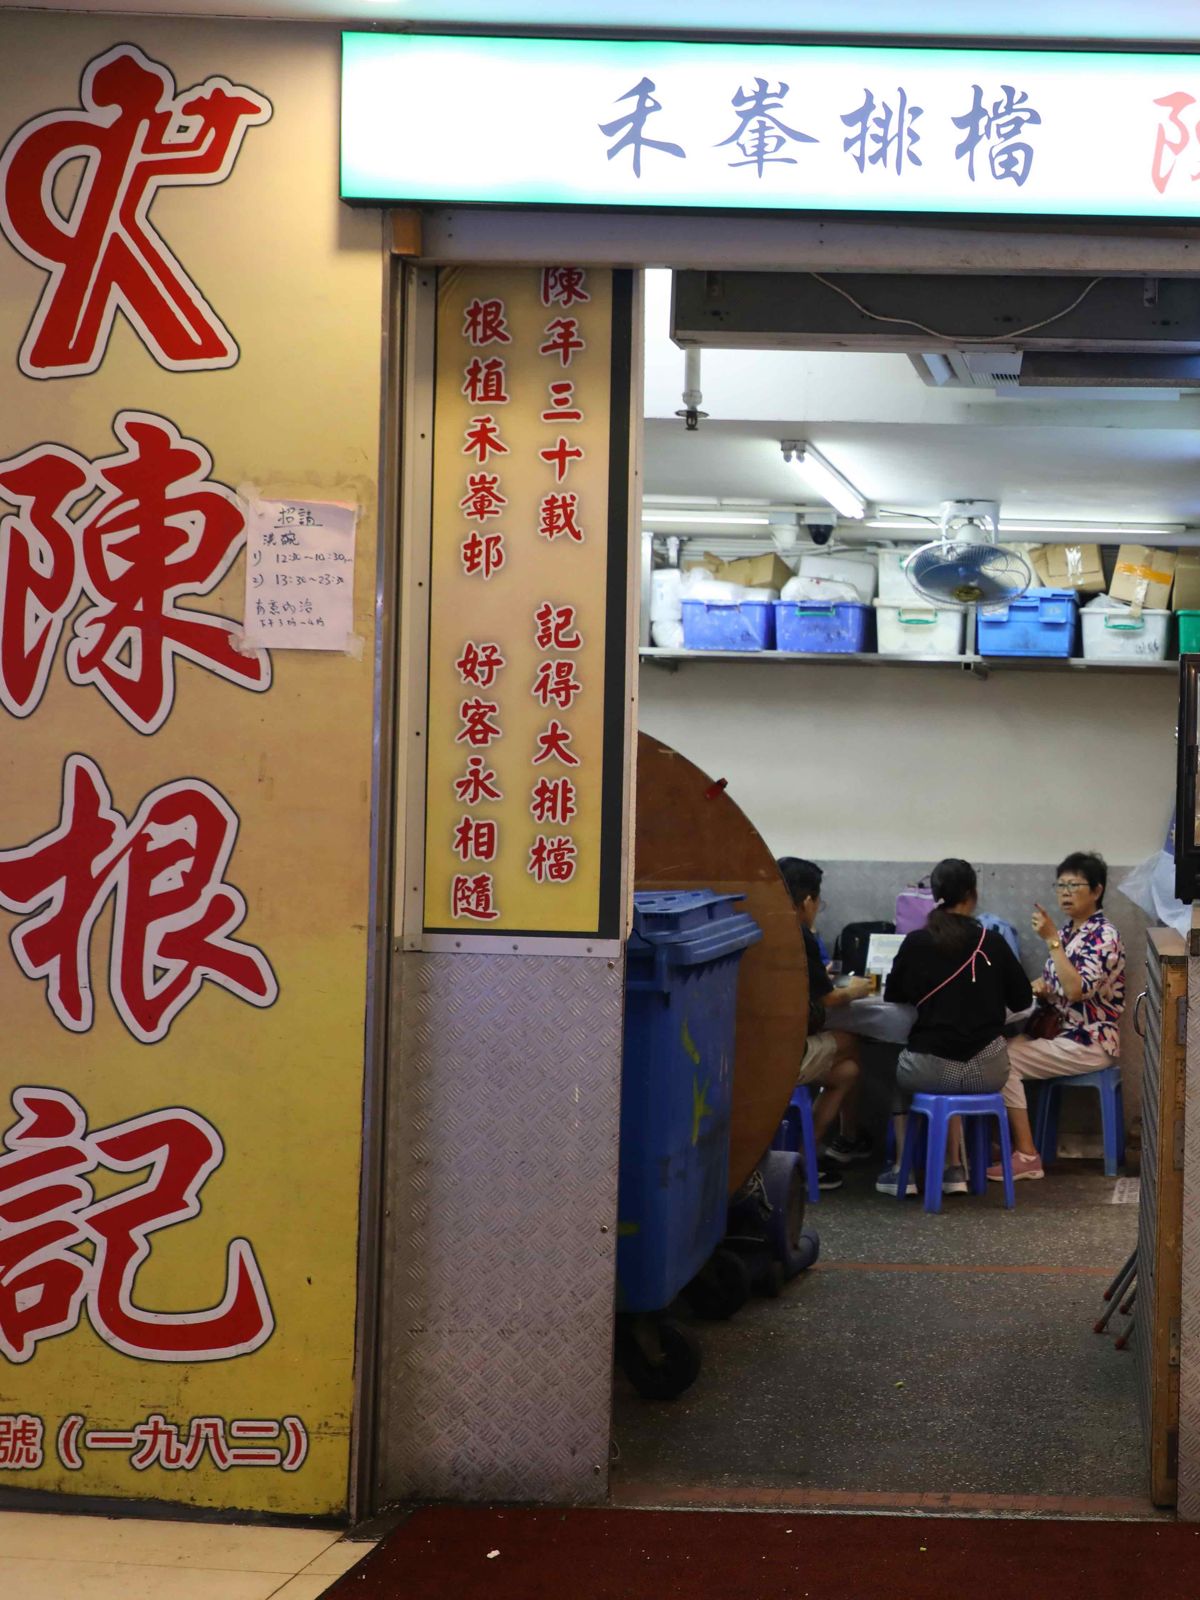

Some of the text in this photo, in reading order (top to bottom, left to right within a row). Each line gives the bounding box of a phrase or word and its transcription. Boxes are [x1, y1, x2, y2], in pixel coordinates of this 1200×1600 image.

[598, 77, 1042, 187] 禾輋排檔
[528, 266, 590, 884] 陳年三十載 記得大排檔
[450, 641, 507, 922] 好客永相隨
